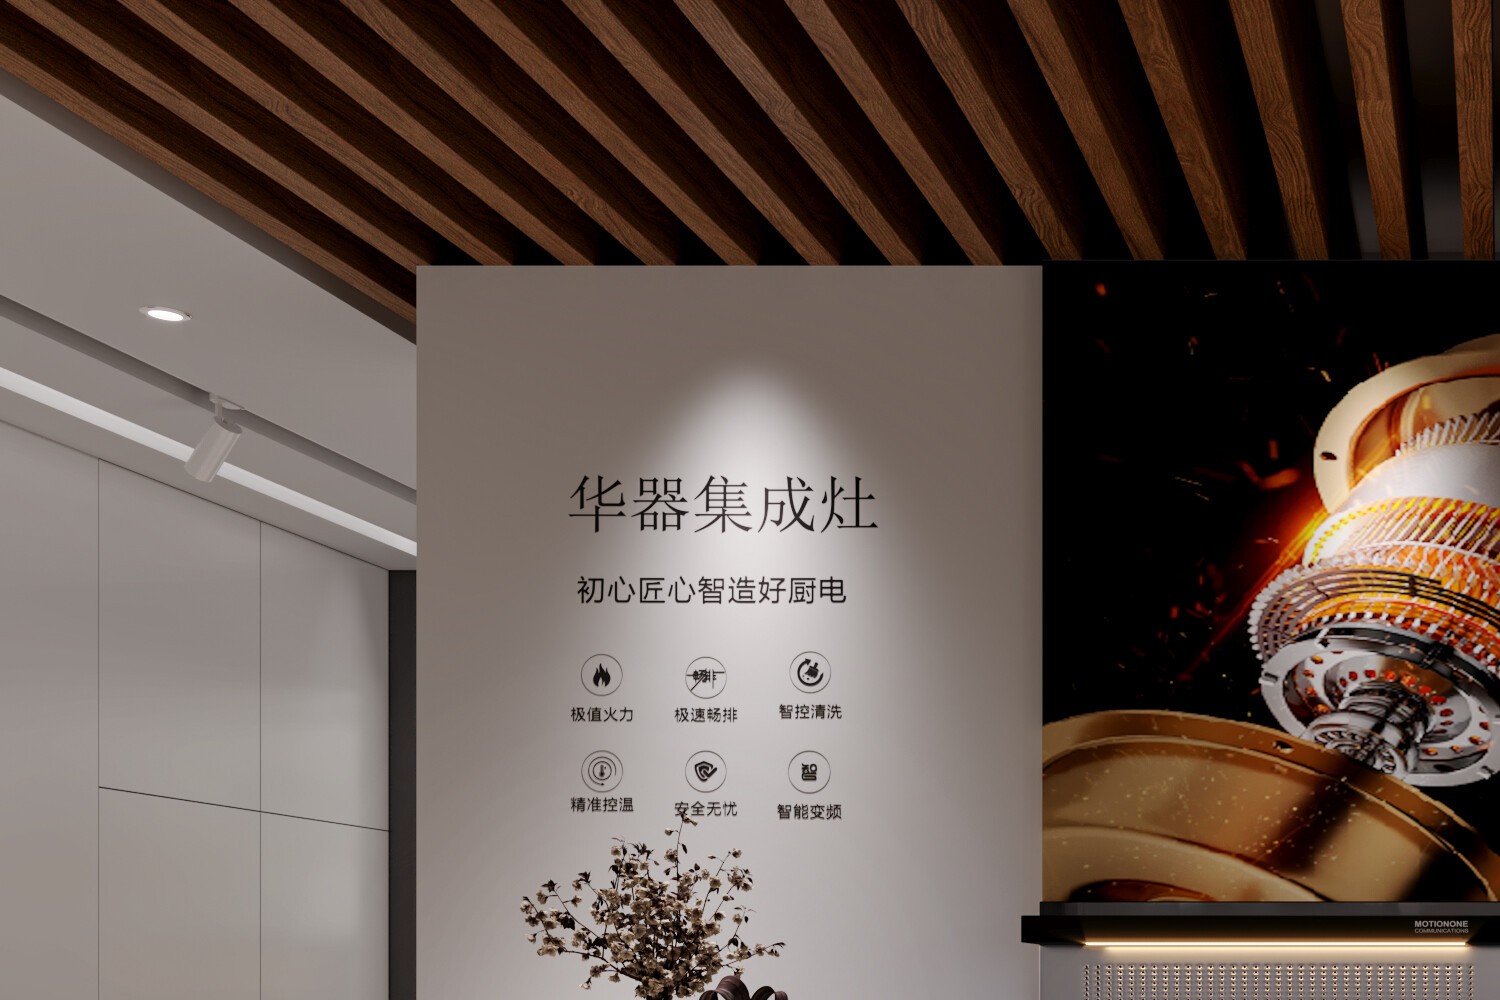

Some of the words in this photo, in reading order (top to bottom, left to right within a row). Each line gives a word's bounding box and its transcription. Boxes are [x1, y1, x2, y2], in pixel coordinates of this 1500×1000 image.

[569, 475, 878, 533] 华器集成灶
[577, 576, 847, 604] 初心匠心智造好厨电
[571, 707, 633, 722] 极值火力
[675, 707, 738, 723] 极速畅排
[779, 704, 842, 720] 智控清洗
[570, 797, 633, 813] 精准控温
[675, 801, 738, 818] 安全无忧
[777, 803, 842, 820] 智能变频
[1414, 920, 1469, 928] MOTIONONE
